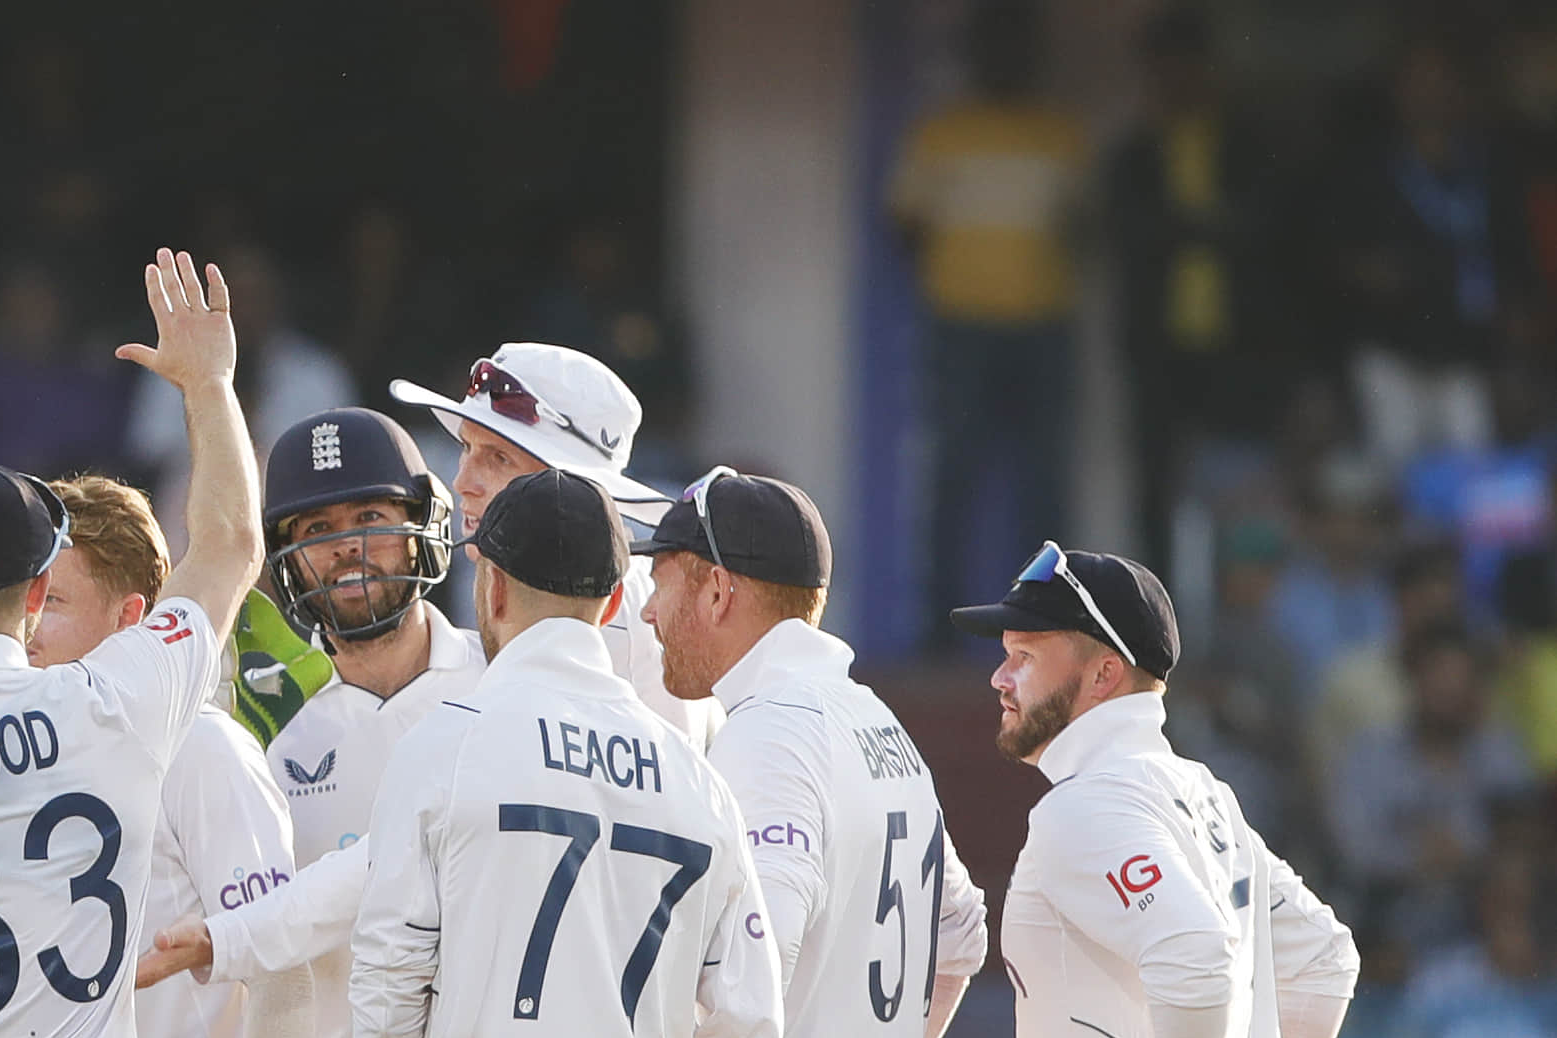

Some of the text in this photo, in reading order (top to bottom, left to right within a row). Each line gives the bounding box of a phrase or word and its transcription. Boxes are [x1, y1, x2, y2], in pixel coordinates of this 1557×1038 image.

[538, 718, 663, 793] LEACH
[746, 821, 810, 853] nch
[220, 866, 290, 910] cinh
[1106, 854, 1163, 910] IG
[1138, 892, 1155, 912] BD
[499, 803, 713, 1033] 77
[869, 809, 945, 1023] 51
